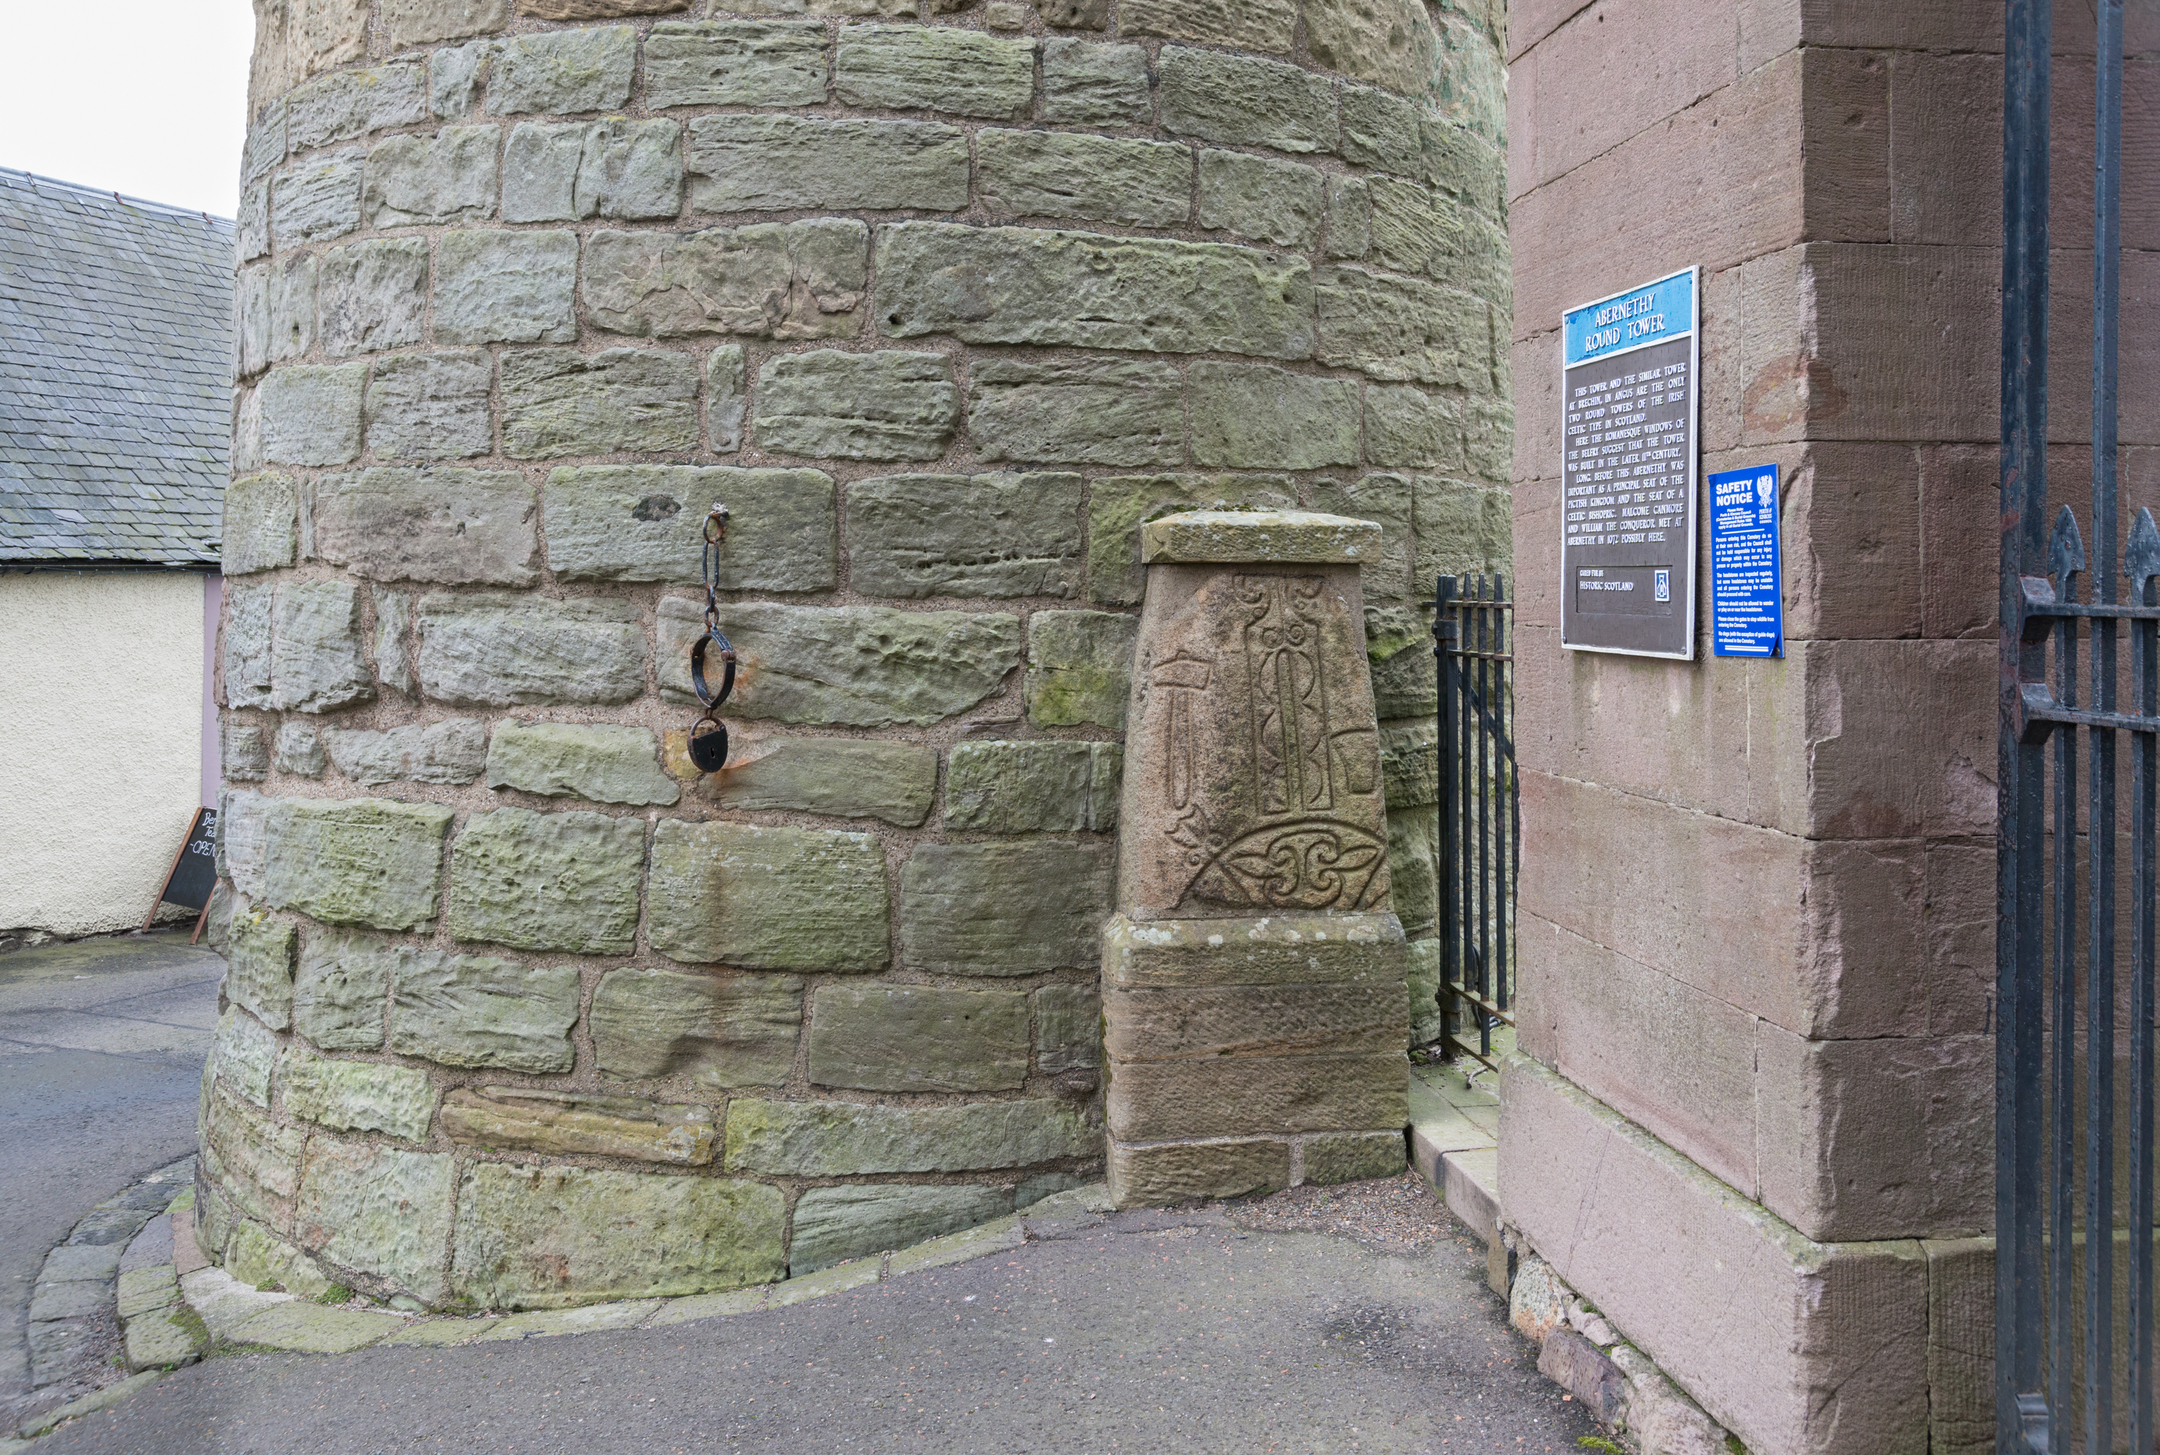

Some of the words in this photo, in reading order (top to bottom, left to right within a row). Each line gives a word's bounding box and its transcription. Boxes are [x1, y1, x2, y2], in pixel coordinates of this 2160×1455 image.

[1595, 293, 1656, 327] ABERNETHY
[1586, 328, 1620, 352] ROUND
[1628, 314, 1666, 339] TOWER
[1575, 386, 1587, 397] THIS
[1589, 382, 1608, 394] TOWER
[1609, 378, 1622, 389] AND
[1624, 374, 1636, 385] THE
[1638, 368, 1662, 382] SIMILAR
[1664, 362, 1686, 376] TOWER
[1569, 401, 1576, 411] AT
[1605, 393, 1611, 403] IN
[1614, 388, 1633, 401] ANGUS
[1636, 385, 1648, 396] ARE
[1651, 381, 1664, 392] THE
[1668, 376, 1684, 388] ONLY
[1568, 413, 1581, 423] TWO
[1585, 408, 1605, 420] ROUND
[1610, 401, 1633, 414] TOWERS
[1638, 398, 1646, 408] OF
[1651, 395, 1663, 406] THE
[1668, 390, 1686, 402] IRISH
[1568, 424, 1586, 435] CELTIC
[1589, 421, 1602, 431] TYPE
[1605, 419, 1612, 429] IN
[1576, 436, 1589, 446] HERE
[1591, 434, 1602, 443] THE
[1605, 426, 1641, 441] ROMANESQUE
[1644, 421, 1672, 433] WINDOWS
[1676, 418, 1685, 428] OF
[1568, 450, 1578, 460] THE
[1582, 447, 1600, 458] BELFRY
[1602, 442, 1625, 454] SUGGEST
[1628, 439, 1643, 450] THAT
[1647, 436, 1659, 447] THE
[1663, 433, 1685, 444] TOWER
[1568, 463, 1578, 471] WAS
[1580, 460, 1595, 470] BUILT
[1598, 459, 1604, 468] IN
[1607, 457, 1619, 466] THE
[1622, 454, 1640, 464] LATER
[1652, 447, 1681, 460] CENTURY.
[1576, 473, 1591, 483] LONG
[1594, 470, 1613, 481] BEFORE
[1616, 468, 1629, 478] THIS
[1633, 462, 1666, 476] ABERNETHY
[1671, 460, 1684, 470] WAS
[1598, 484, 1605, 493] AS
[1607, 484, 1612, 492] A
[1613, 480, 1641, 491] PRINCIPAL
[1643, 478, 1656, 488] SEAT
[1659, 476, 1668, 486] OF
[1671, 474, 1684, 485] THE
[1716, 480, 1753, 495] SAFETY
[1568, 499, 1587, 508] PICTISH
[1590, 496, 1614, 506] KINGDOM
[1617, 494, 1630, 504] AND
[1633, 492, 1645, 502] THE
[1649, 490, 1664, 501] SEAT
[1666, 489, 1675, 499] OF
[1679, 489, 1684, 498] A
[1716, 492, 1753, 506] NOTICE
[1567, 511, 1586, 521] CELTIC
[1653, 503, 1683, 514] CANMORE
[1568, 524, 1578, 533] AND
[1581, 523, 1603, 532] WILLIAM
[1606, 522, 1617, 531] THE
[1620, 519, 1656, 531] CONQUEROR
[1659, 517, 1672, 527] MET
[1675, 517, 1683, 527] AT
[1567, 536, 1596, 545] ABERNETHY
[1598, 535, 1604, 544] IN
[1621, 533, 1646, 543] POSSIBLY
[1648, 532, 1666, 542] HERE.
[1580, 581, 1604, 590] HISTORIC
[1604, 582, 1634, 591] SCOTLAND
